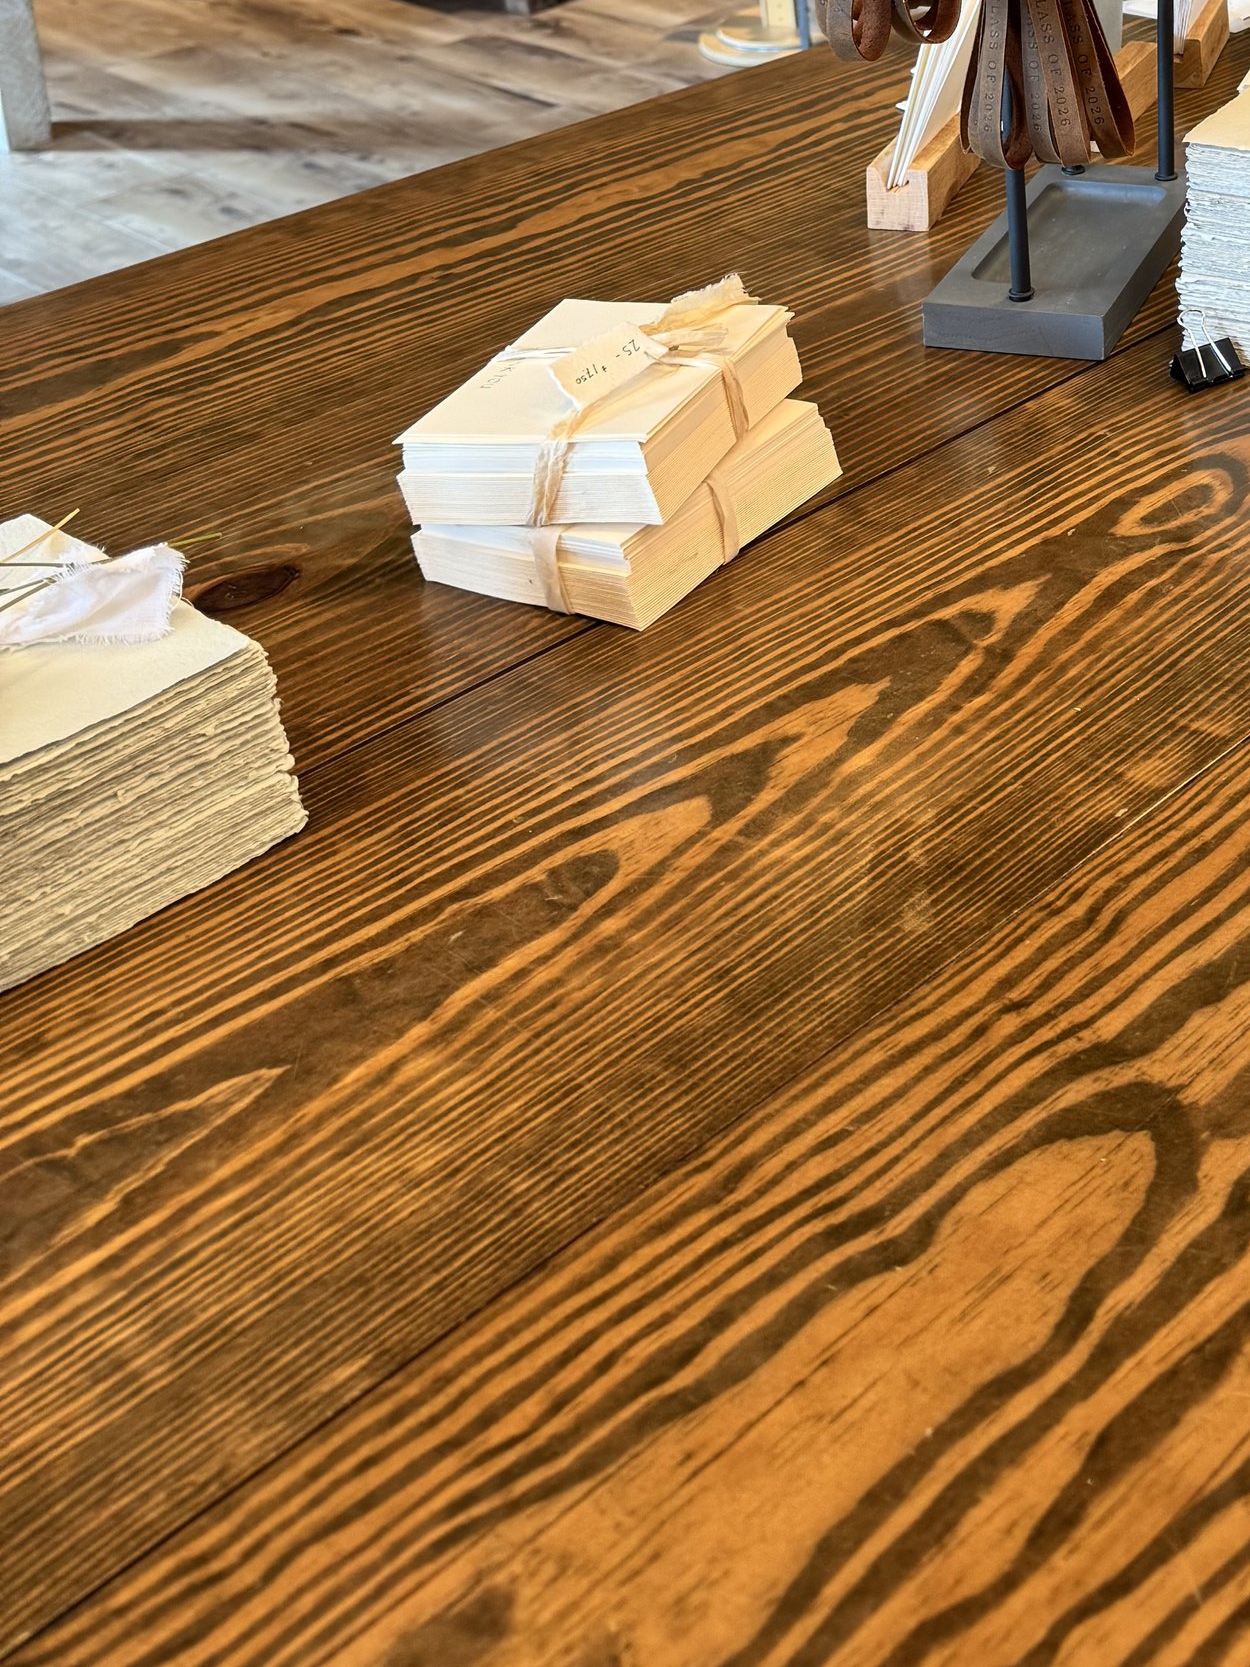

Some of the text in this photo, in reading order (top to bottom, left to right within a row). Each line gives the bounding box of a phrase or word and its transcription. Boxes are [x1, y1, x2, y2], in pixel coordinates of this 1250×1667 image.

[986, 61, 997, 84] OF
[1027, 59, 1040, 83] OF
[1047, 53, 1062, 77] OF
[1054, 85, 1071, 127] 2026
[1077, 53, 1093, 77] OF
[1085, 85, 1105, 126] 2026
[983, 92, 995, 133] 2026
[1030, 92, 1041, 132] 2026
